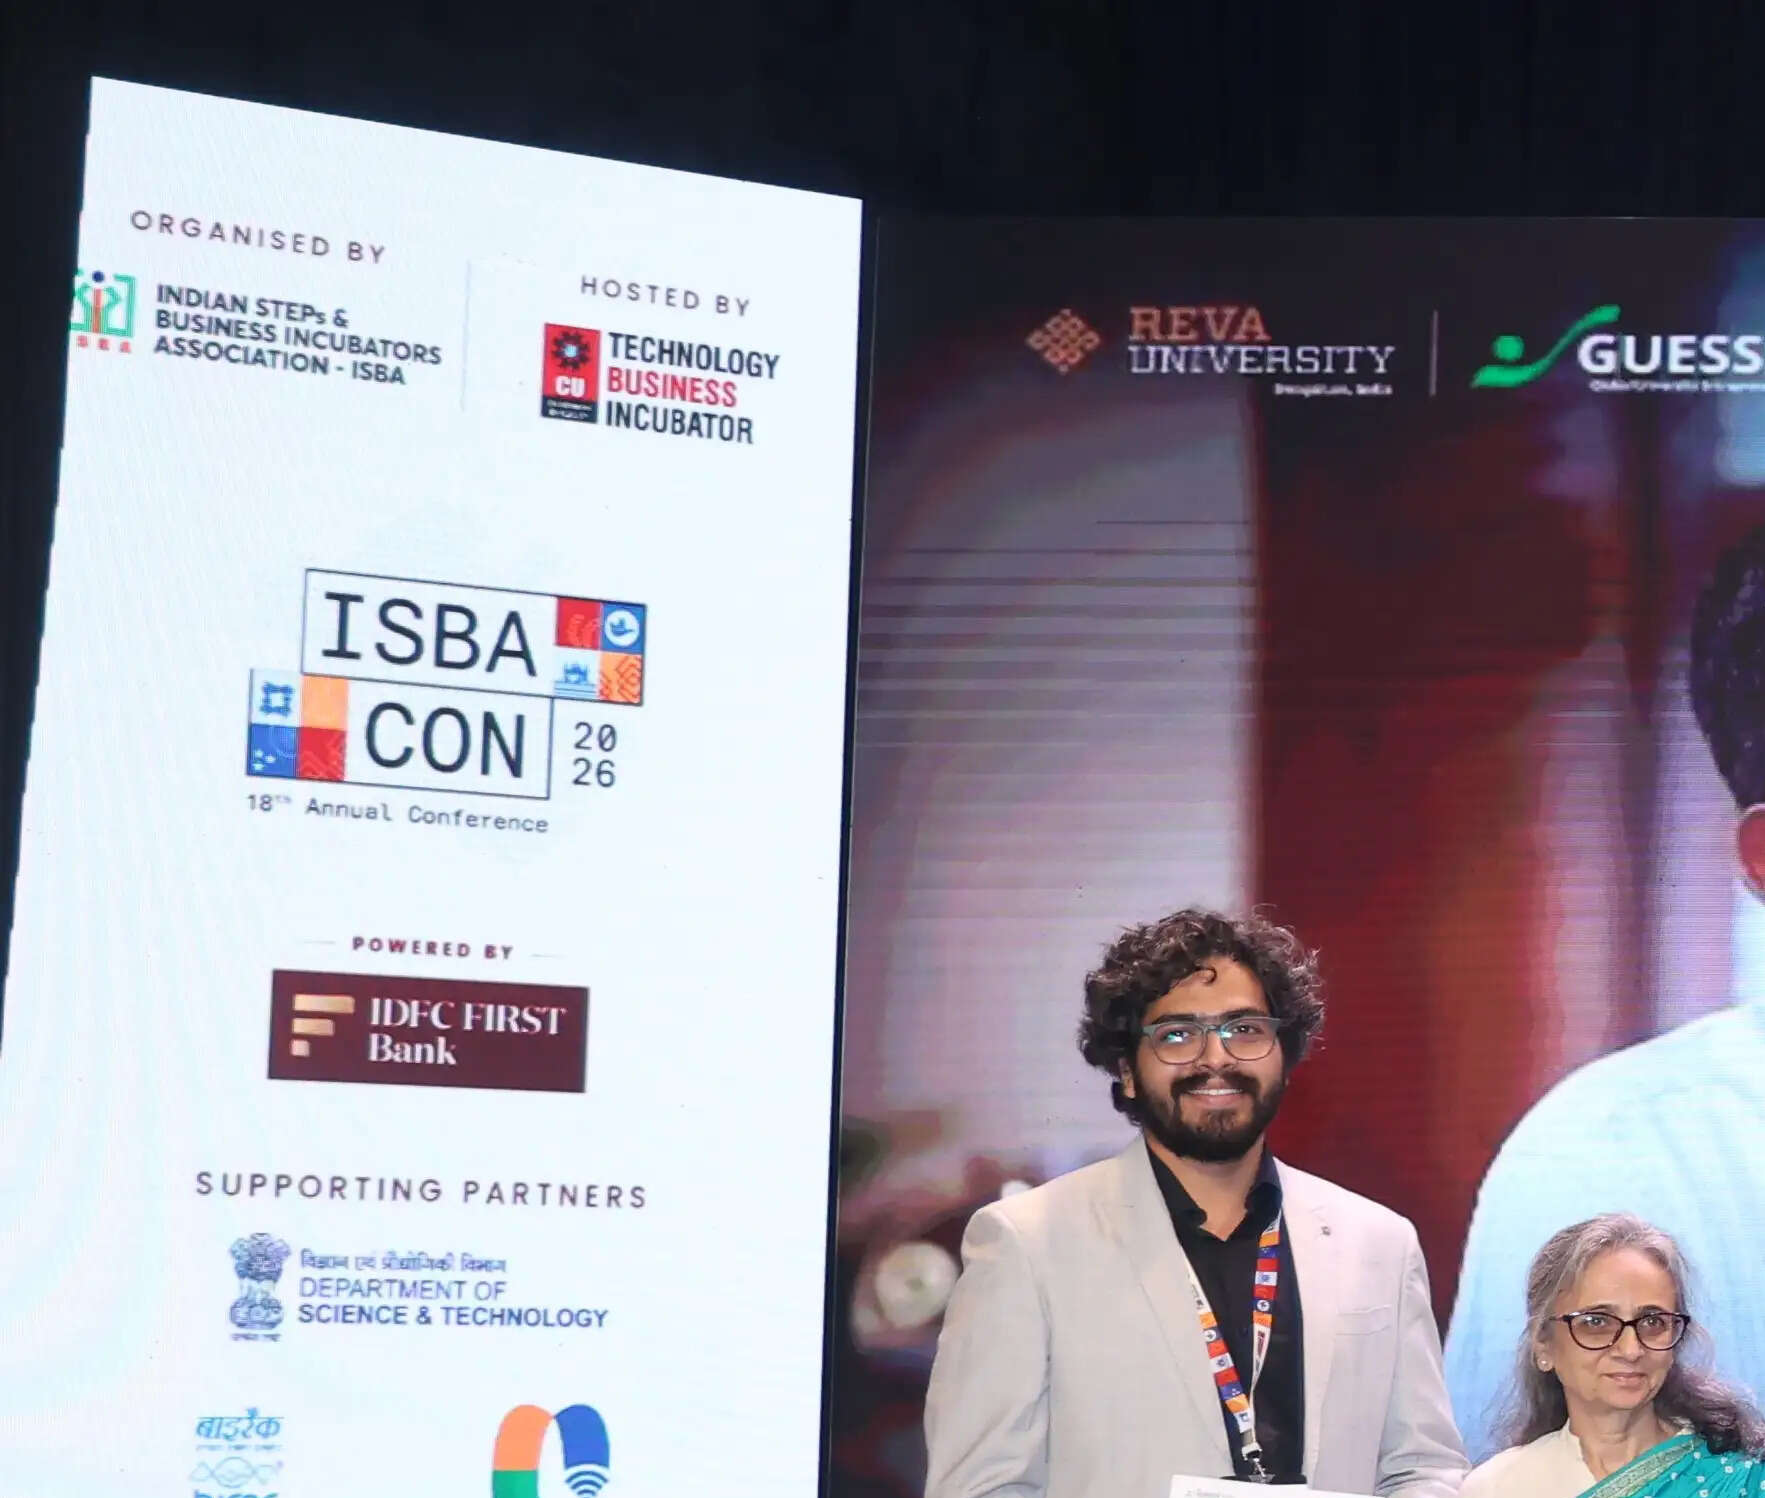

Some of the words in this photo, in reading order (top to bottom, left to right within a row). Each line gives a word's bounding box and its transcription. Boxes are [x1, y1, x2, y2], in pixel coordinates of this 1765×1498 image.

[131, 209, 330, 257] ORGANISED
[347, 241, 386, 265] BY
[157, 284, 248, 315] INDIAN
[256, 298, 326, 326] STEPs
[333, 308, 349, 328] &
[581, 275, 701, 311] HOSTED
[716, 295, 750, 317] BY
[156, 309, 277, 344] BUSINESS
[284, 326, 442, 366] INCUBATORS
[1129, 306, 1272, 342] REVA
[154, 335, 329, 376] ASSOCIATION
[352, 361, 406, 386] ISBA
[608, 332, 780, 380] TECHNOLOGY
[1128, 345, 1396, 374] UNIVERSITY
[607, 366, 738, 408] BUSINESS
[605, 401, 754, 444] INCUBATOR
[322, 591, 538, 678] ISBA
[365, 701, 525, 779] CON
[574, 720, 618, 753] 20
[572, 757, 616, 788] 26
[305, 797, 392, 823] Annual
[408, 804, 549, 834] Conference
[351, 936, 470, 958] POWERED
[484, 944, 513, 960] BY
[369, 997, 455, 1030] IDFC
[462, 1001, 568, 1035] FIRST
[368, 1033, 457, 1065] Bank
[196, 1171, 442, 1203] SUPPORTING
[463, 1181, 647, 1209] PARTNERS
[300, 1277, 466, 1300] DEPARTMENT
[474, 1280, 507, 1300] OF
[298, 1304, 408, 1325] SCIENCE
[417, 1306, 432, 1325] &
[440, 1306, 609, 1328] TECHNOLOGY
